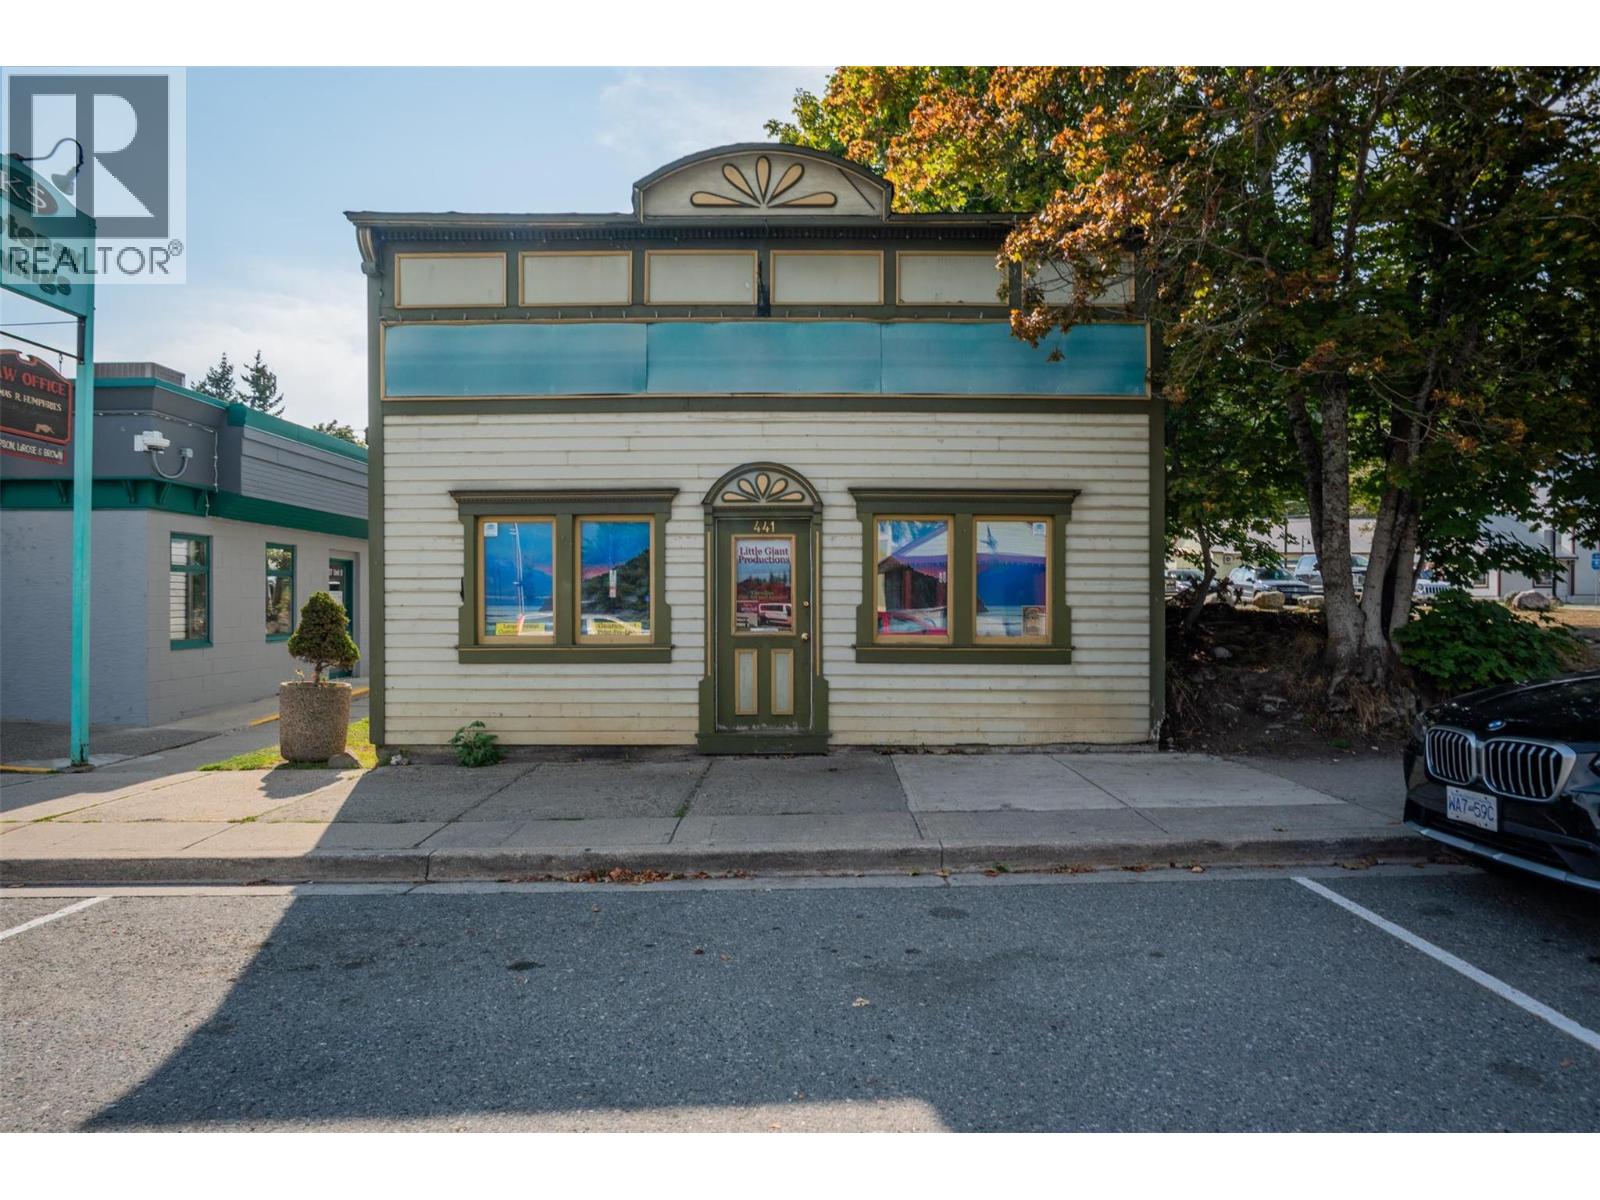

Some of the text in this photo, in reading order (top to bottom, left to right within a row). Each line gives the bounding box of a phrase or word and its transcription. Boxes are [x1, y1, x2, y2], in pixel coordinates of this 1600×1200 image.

[22, 372, 65, 397] OFFICE
[753, 520, 775, 533] 441
[739, 546, 789, 557] Little Giant
[738, 555, 791, 565] Productions
